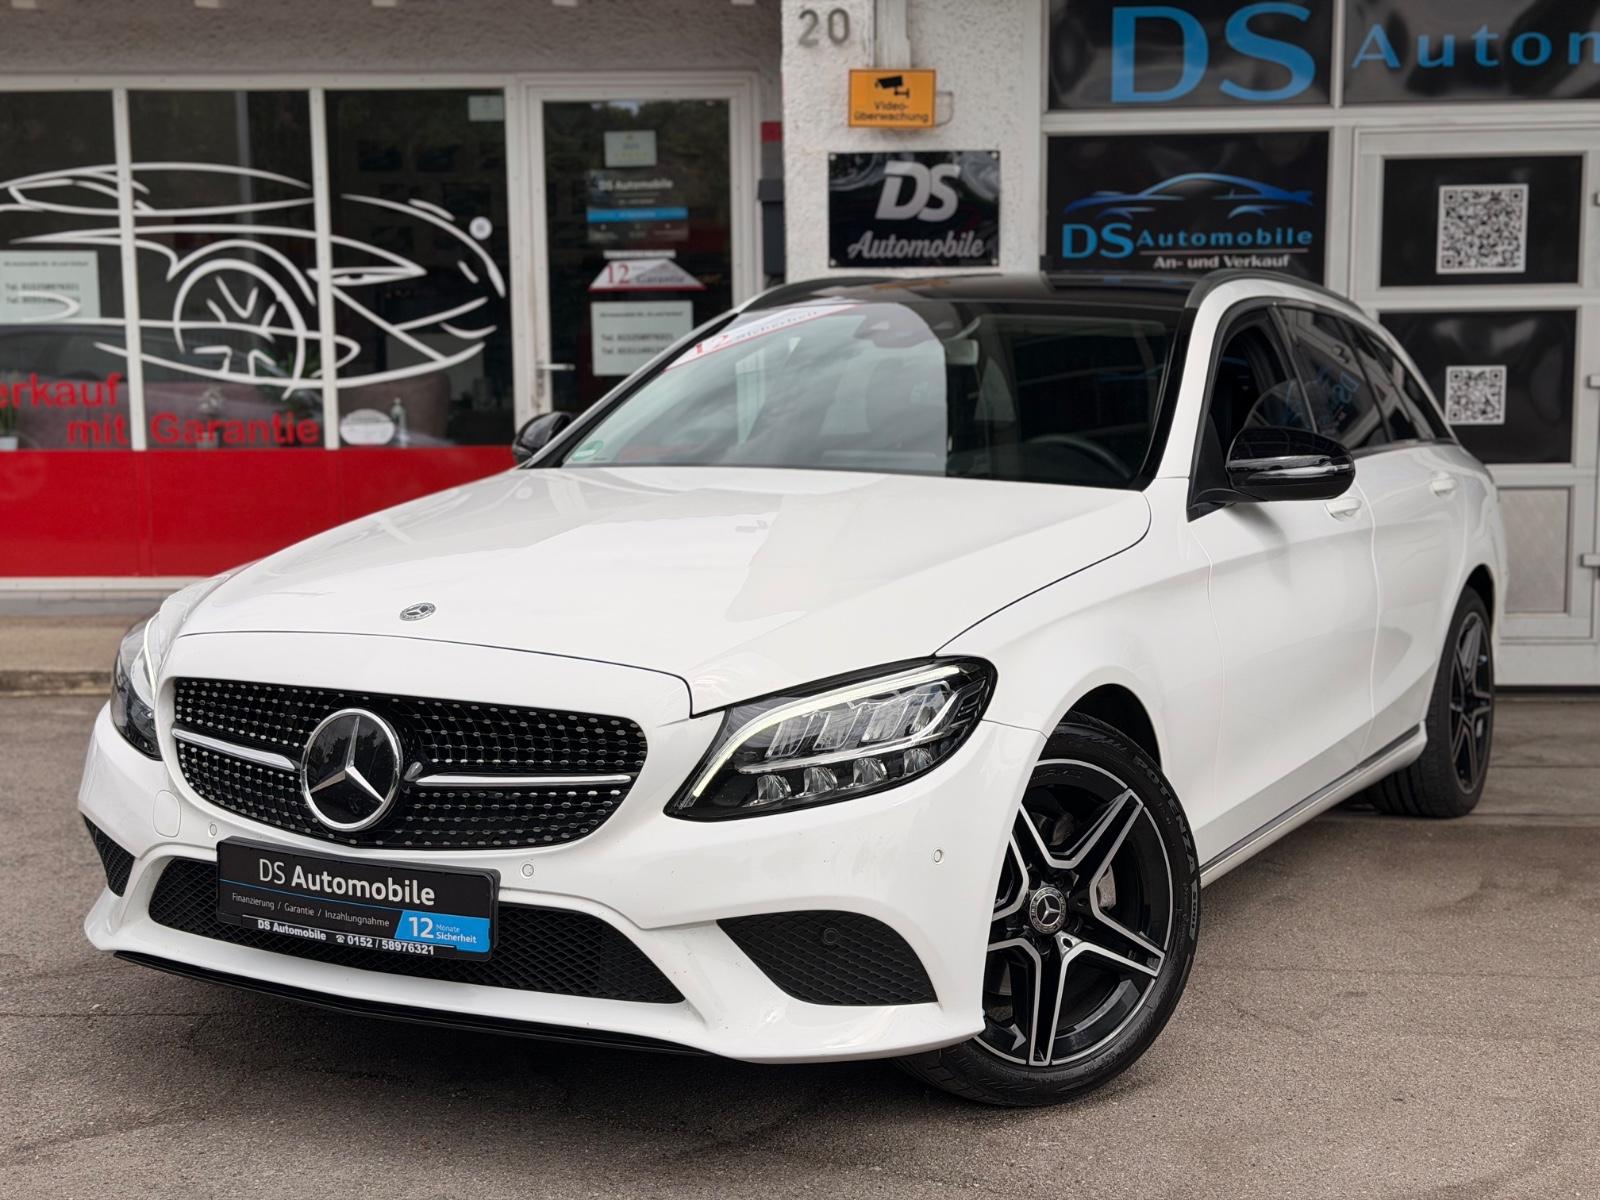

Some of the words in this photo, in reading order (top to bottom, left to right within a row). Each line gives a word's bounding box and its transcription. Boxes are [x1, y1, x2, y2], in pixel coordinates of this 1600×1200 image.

[798, 8, 849, 46] 20
[1111, 3, 1316, 103] DS
[873, 101, 909, 111] Video-
[875, 160, 961, 222] DS
[847, 230, 986, 260] Automobile
[1061, 222, 1134, 259] DS
[1136, 227, 1313, 248] Automobile
[1153, 256, 1184, 269] An-
[1186, 255, 1219, 269] und
[1222, 254, 1291, 268] Verkauf
[67, 412, 129, 446] mit
[151, 411, 320, 445] Garantie
[259, 858, 286, 885] DS
[291, 865, 435, 906] Automobile
[231, 892, 275, 911] Finanzierung
[284, 902, 315, 917] Garantie
[325, 909, 390, 928] Inzahlungnahme
[408, 916, 434, 939] 12
[257, 919, 271, 930] DS
[272, 922, 327, 941] Automobile
[347, 935, 373, 948] 0152
[381, 940, 434, 955] 58976321
[436, 931, 477, 944] Sicherheit
